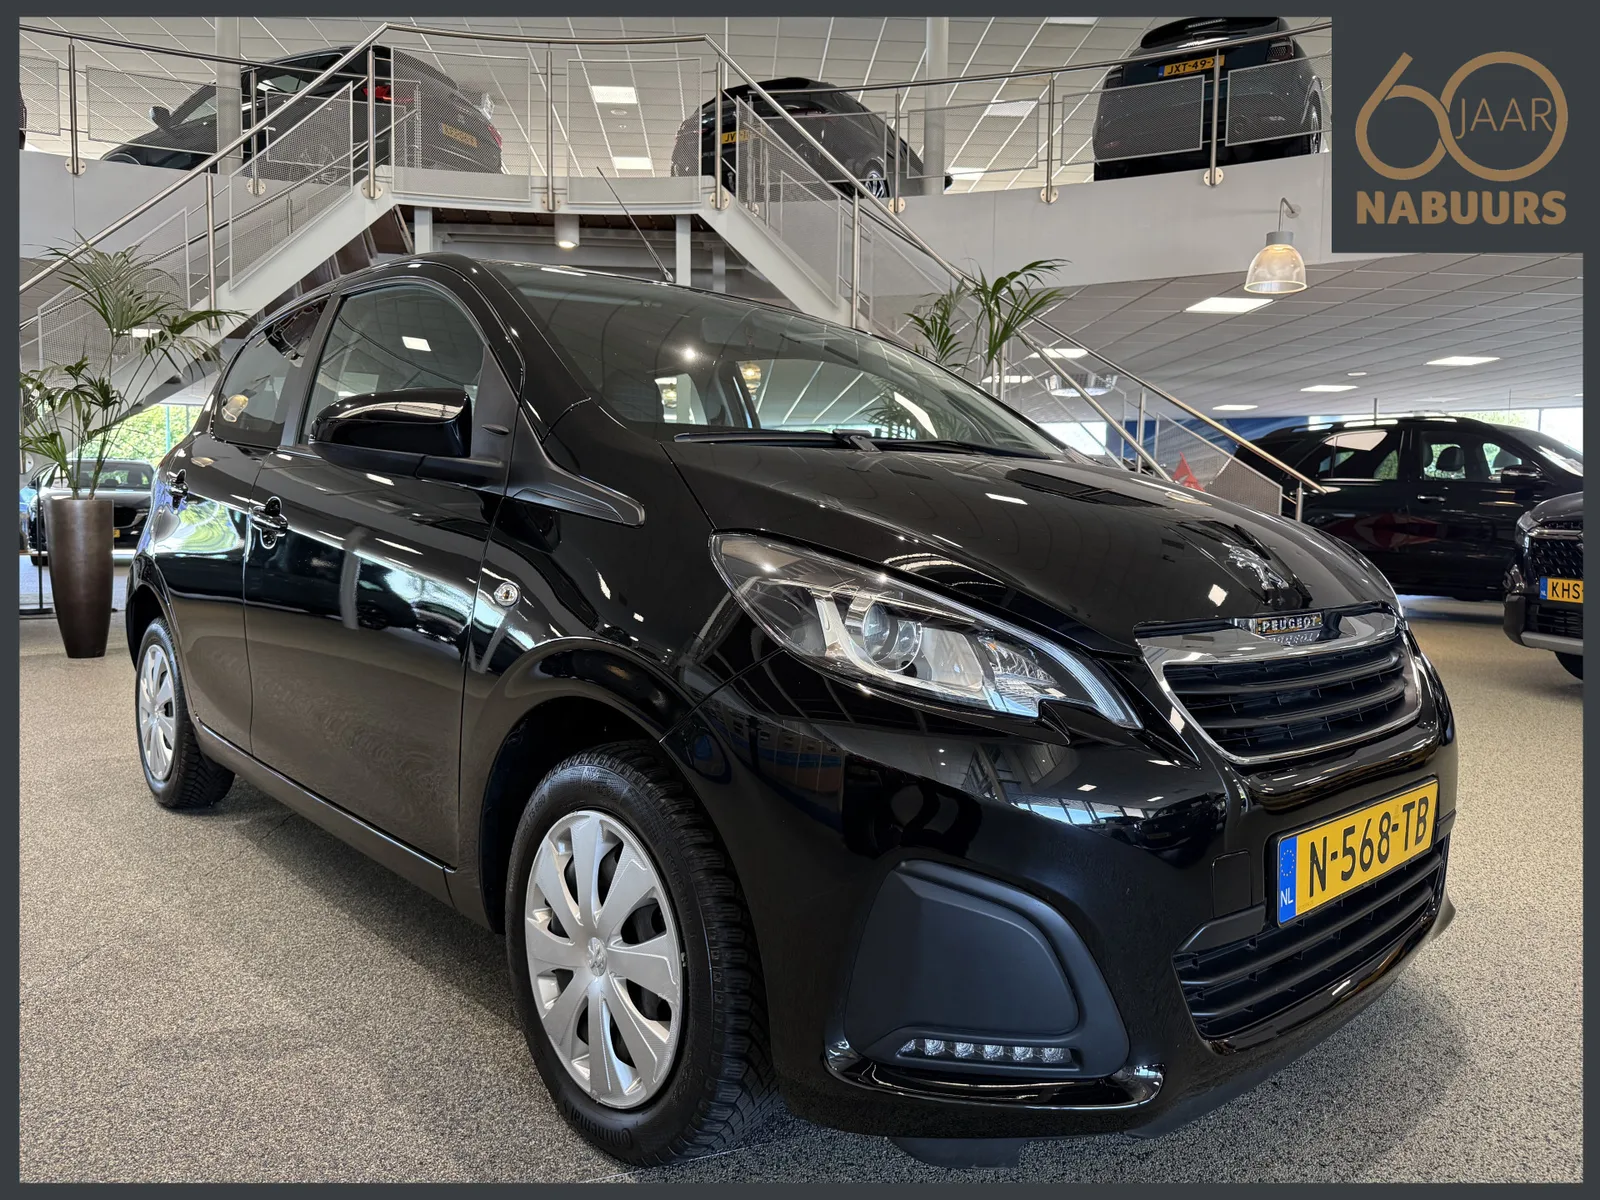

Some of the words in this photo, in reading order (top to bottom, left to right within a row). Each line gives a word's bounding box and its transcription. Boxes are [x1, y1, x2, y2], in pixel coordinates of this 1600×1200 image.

[1262, 615, 1317, 632] PEUGEOT
[1280, 887, 1294, 908] NL
[1309, 796, 1429, 898] N-568-TB
